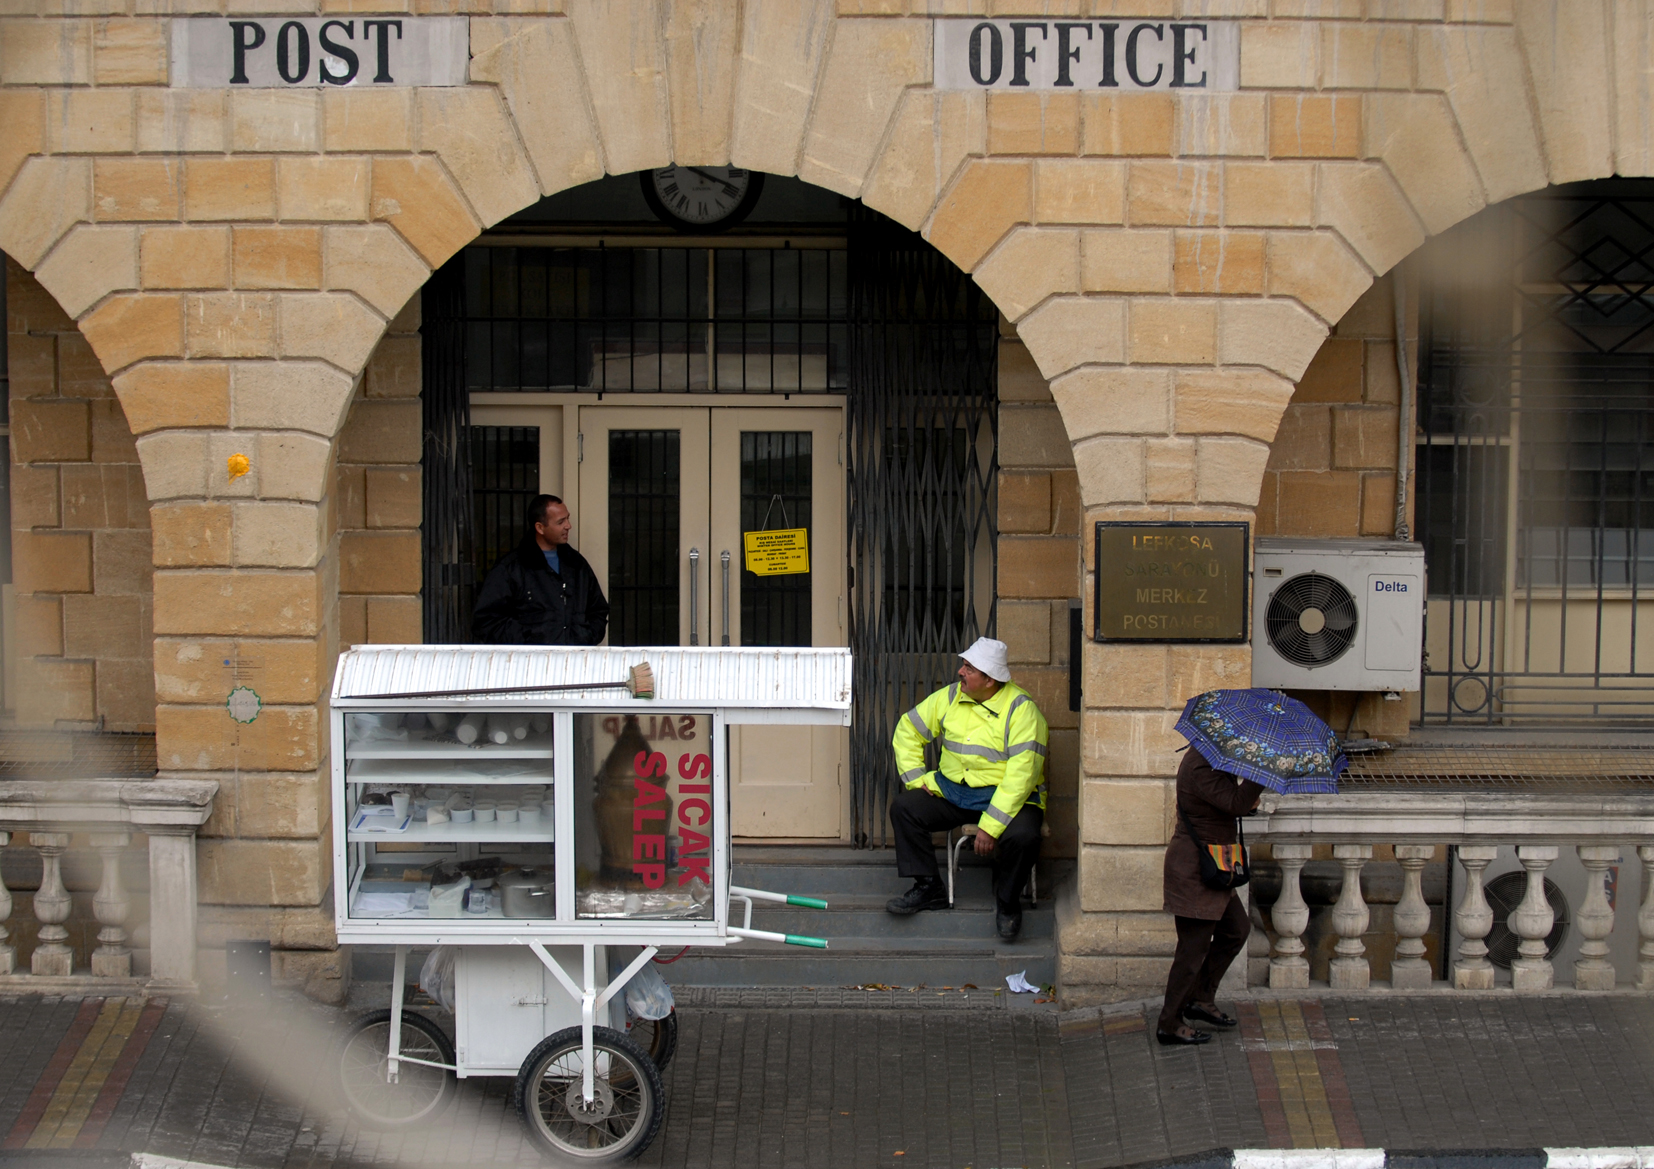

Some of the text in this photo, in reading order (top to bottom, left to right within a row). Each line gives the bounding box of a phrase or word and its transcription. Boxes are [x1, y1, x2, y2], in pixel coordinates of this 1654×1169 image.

[229, 20, 1208, 88] POST OFFICE
[1136, 588, 1208, 604] MERKEZ
[1375, 581, 1407, 592] Delta
[632, 750, 668, 889] SALEP
[678, 753, 711, 887] SICAK
